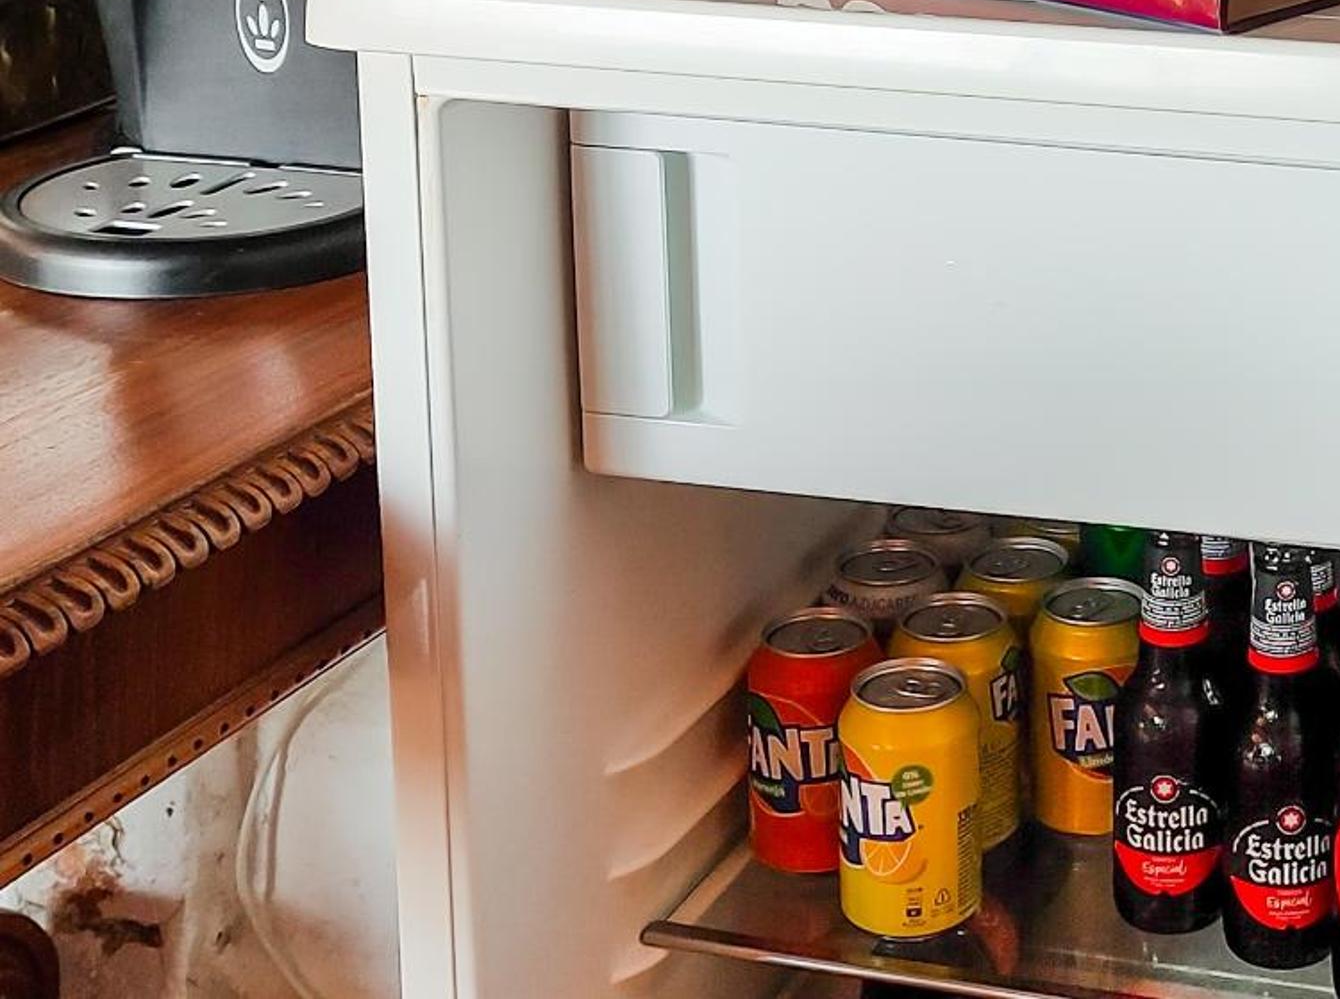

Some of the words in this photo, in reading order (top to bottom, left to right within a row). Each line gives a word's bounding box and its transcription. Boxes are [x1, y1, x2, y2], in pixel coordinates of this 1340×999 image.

[1151, 572, 1193, 588] Estrella
[1264, 598, 1307, 613] Estrella
[1266, 610, 1305, 625] Galicia
[992, 674, 1018, 719] FA
[747, 722, 841, 782] ANT
[840, 775, 914, 837] NTA
[1125, 798, 1208, 829] Estrella
[1126, 823, 1205, 853] Galicia
[1245, 833, 1331, 861] Estrella
[1141, 859, 1188, 877] Especial
[1248, 858, 1327, 886] Galicia
[1266, 889, 1313, 911] Especial
